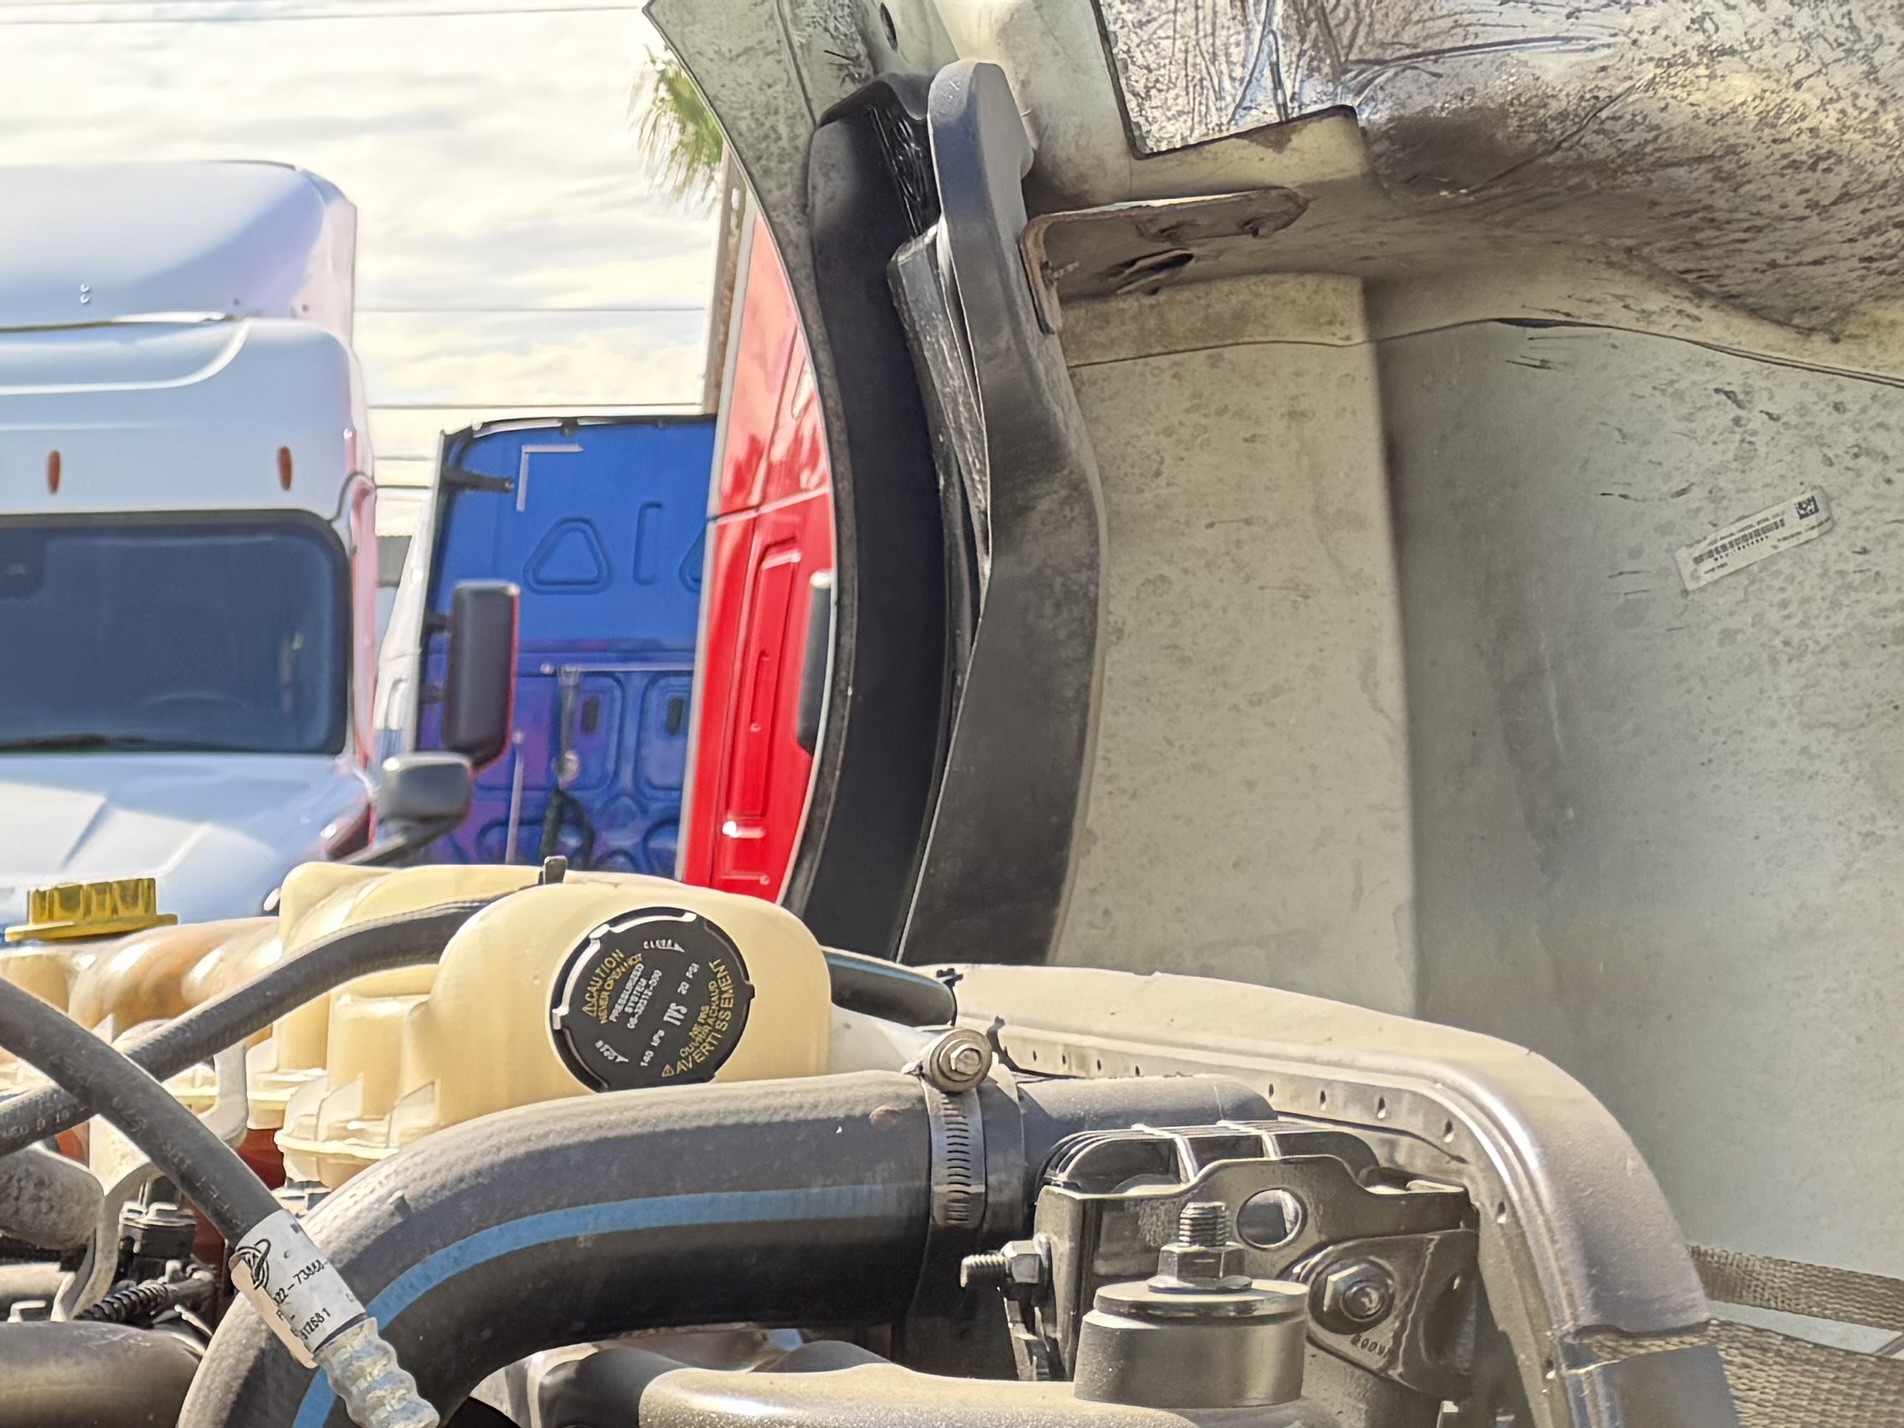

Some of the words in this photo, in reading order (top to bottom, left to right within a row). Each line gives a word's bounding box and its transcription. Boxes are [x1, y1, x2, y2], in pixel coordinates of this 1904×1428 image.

[585, 949, 625, 1003] CAUTION
[623, 977, 648, 1014] SYSTEM
[663, 1001, 689, 1026] TVS
